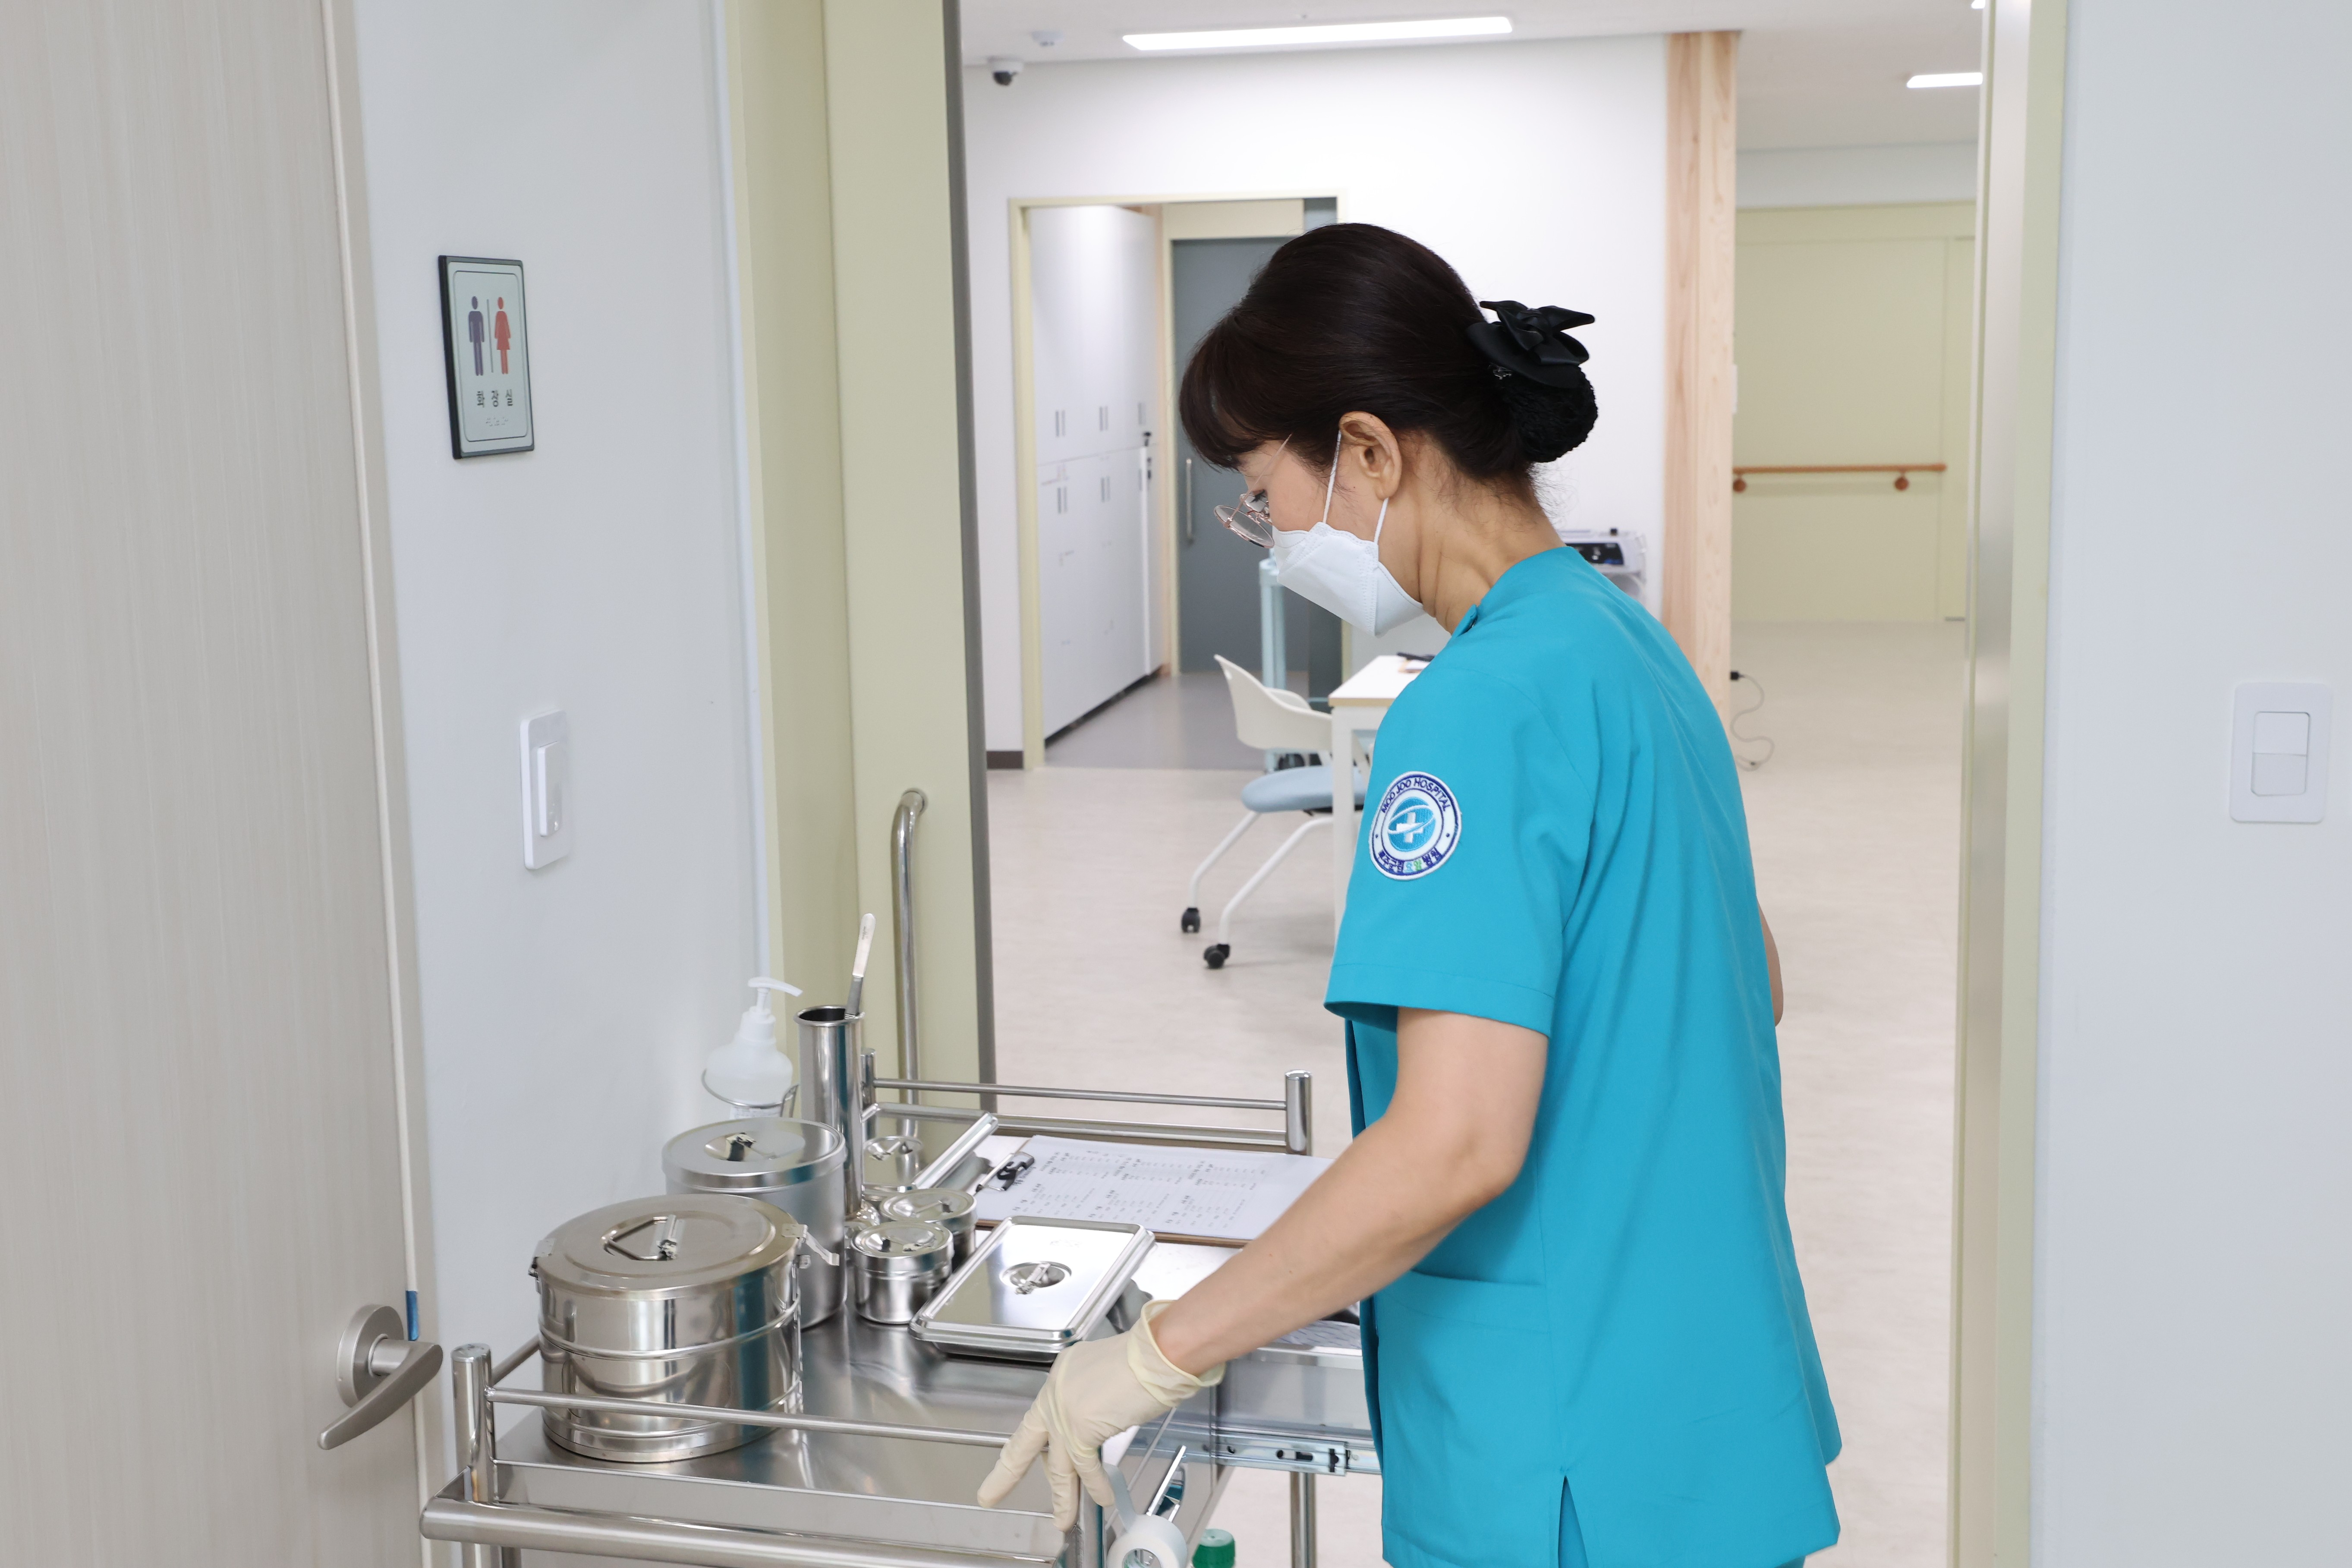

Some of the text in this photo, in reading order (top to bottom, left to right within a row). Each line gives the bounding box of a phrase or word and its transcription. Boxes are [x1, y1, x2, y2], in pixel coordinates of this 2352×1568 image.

[1381, 778, 1451, 813] MOO JOO HOSPITAL
